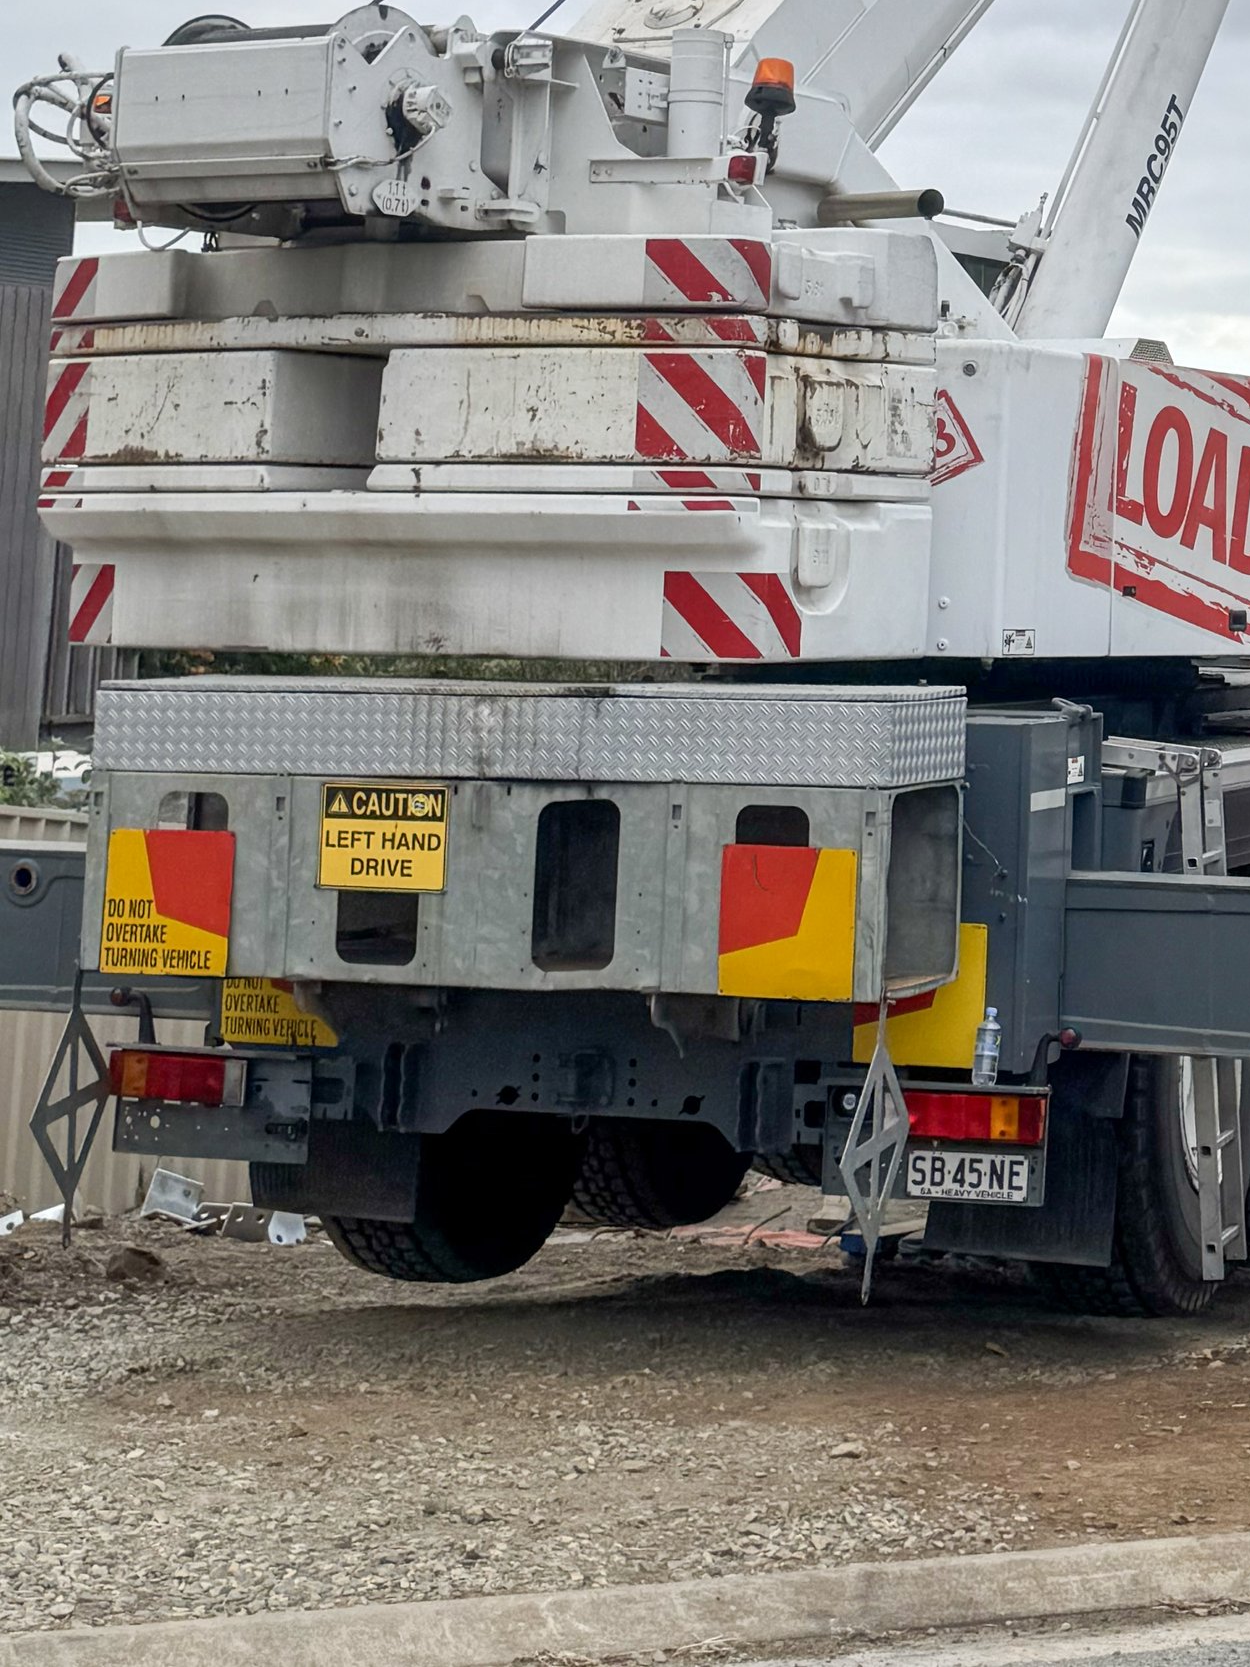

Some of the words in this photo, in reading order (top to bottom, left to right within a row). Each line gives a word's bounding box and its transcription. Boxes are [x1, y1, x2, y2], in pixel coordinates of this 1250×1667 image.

[1125, 93, 1183, 239] MRC95T
[352, 791, 442, 817] CAUTIN
[325, 829, 375, 849] LEFT
[381, 831, 441, 852] HAND
[350, 857, 413, 877] DRIVE
[108, 898, 125, 919] DO
[129, 899, 154, 919] NOT
[106, 922, 168, 944] OVERTAKE
[104, 947, 158, 968] TURNING
[162, 948, 212, 970] VEHICLE
[225, 993, 280, 1014] OVERTAKE
[224, 1016, 271, 1036] TURNING
[273, 1018, 318, 1039] VEHICLE
[941, 1188, 973, 1198] HEAVY
[974, 1189, 1014, 1200] VEHICLE
